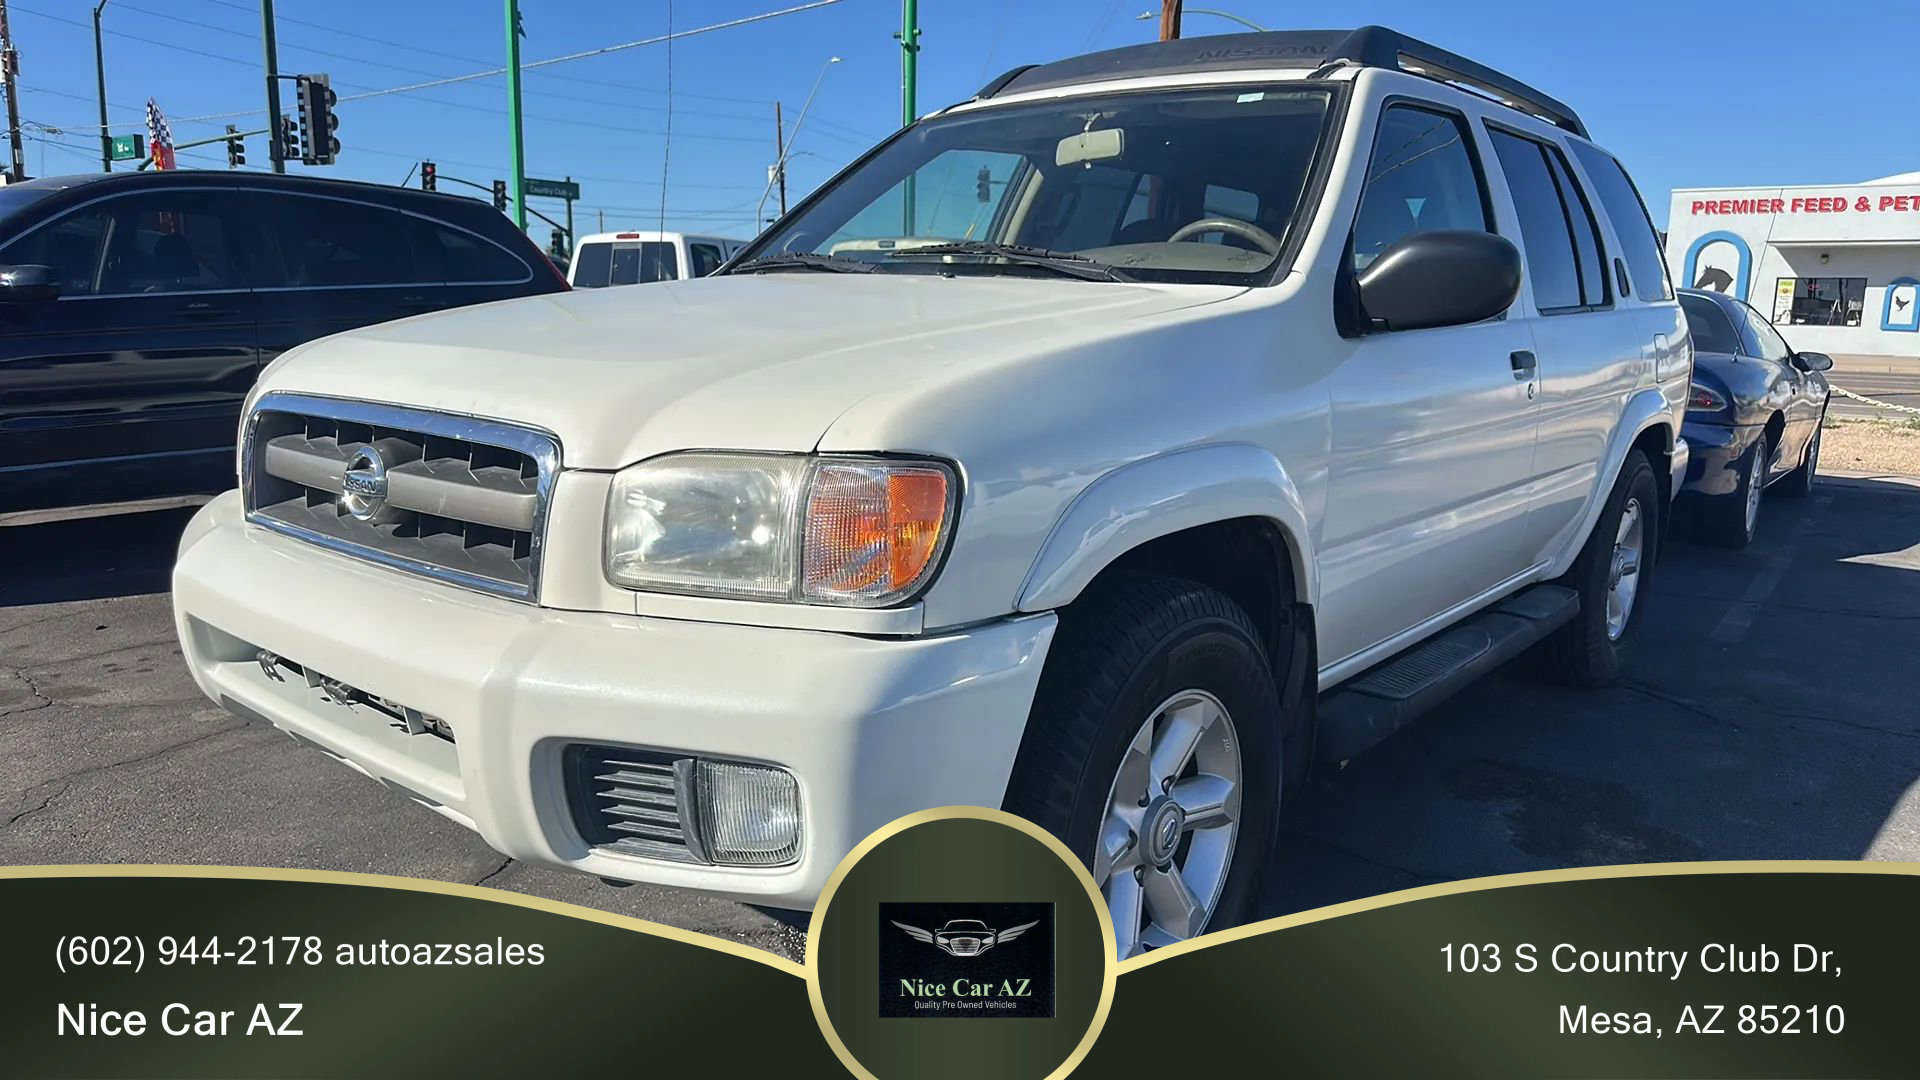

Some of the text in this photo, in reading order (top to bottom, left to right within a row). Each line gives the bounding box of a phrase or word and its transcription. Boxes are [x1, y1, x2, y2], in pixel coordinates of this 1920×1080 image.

[1197, 45, 1328, 60] NISSAN
[1691, 195, 1920, 215] PREMIER FEED & PET
